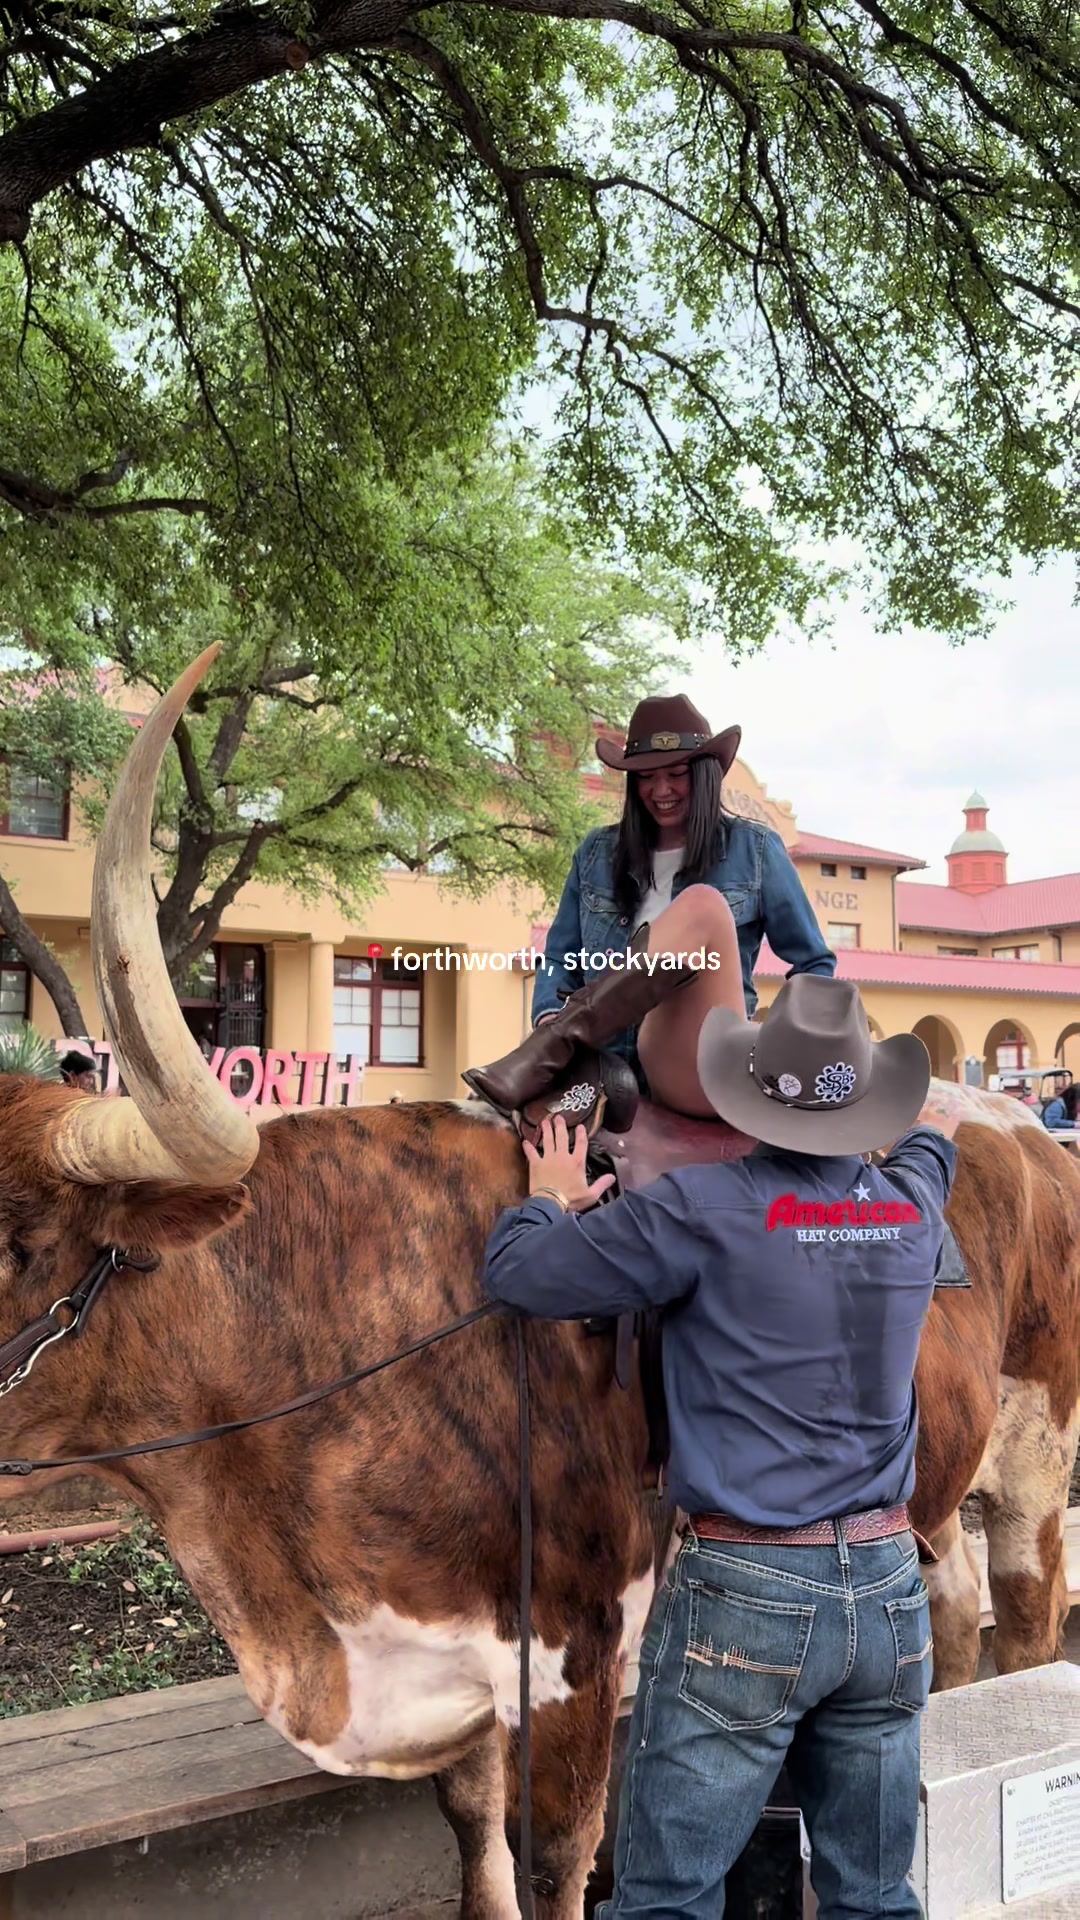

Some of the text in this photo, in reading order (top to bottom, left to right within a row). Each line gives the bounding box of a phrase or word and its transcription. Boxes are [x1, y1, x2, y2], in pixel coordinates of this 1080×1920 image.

[208, 1045, 359, 1106] ORTH
[766, 1192, 922, 1231] American
[796, 1227, 901, 1242] HAT COMPANY
